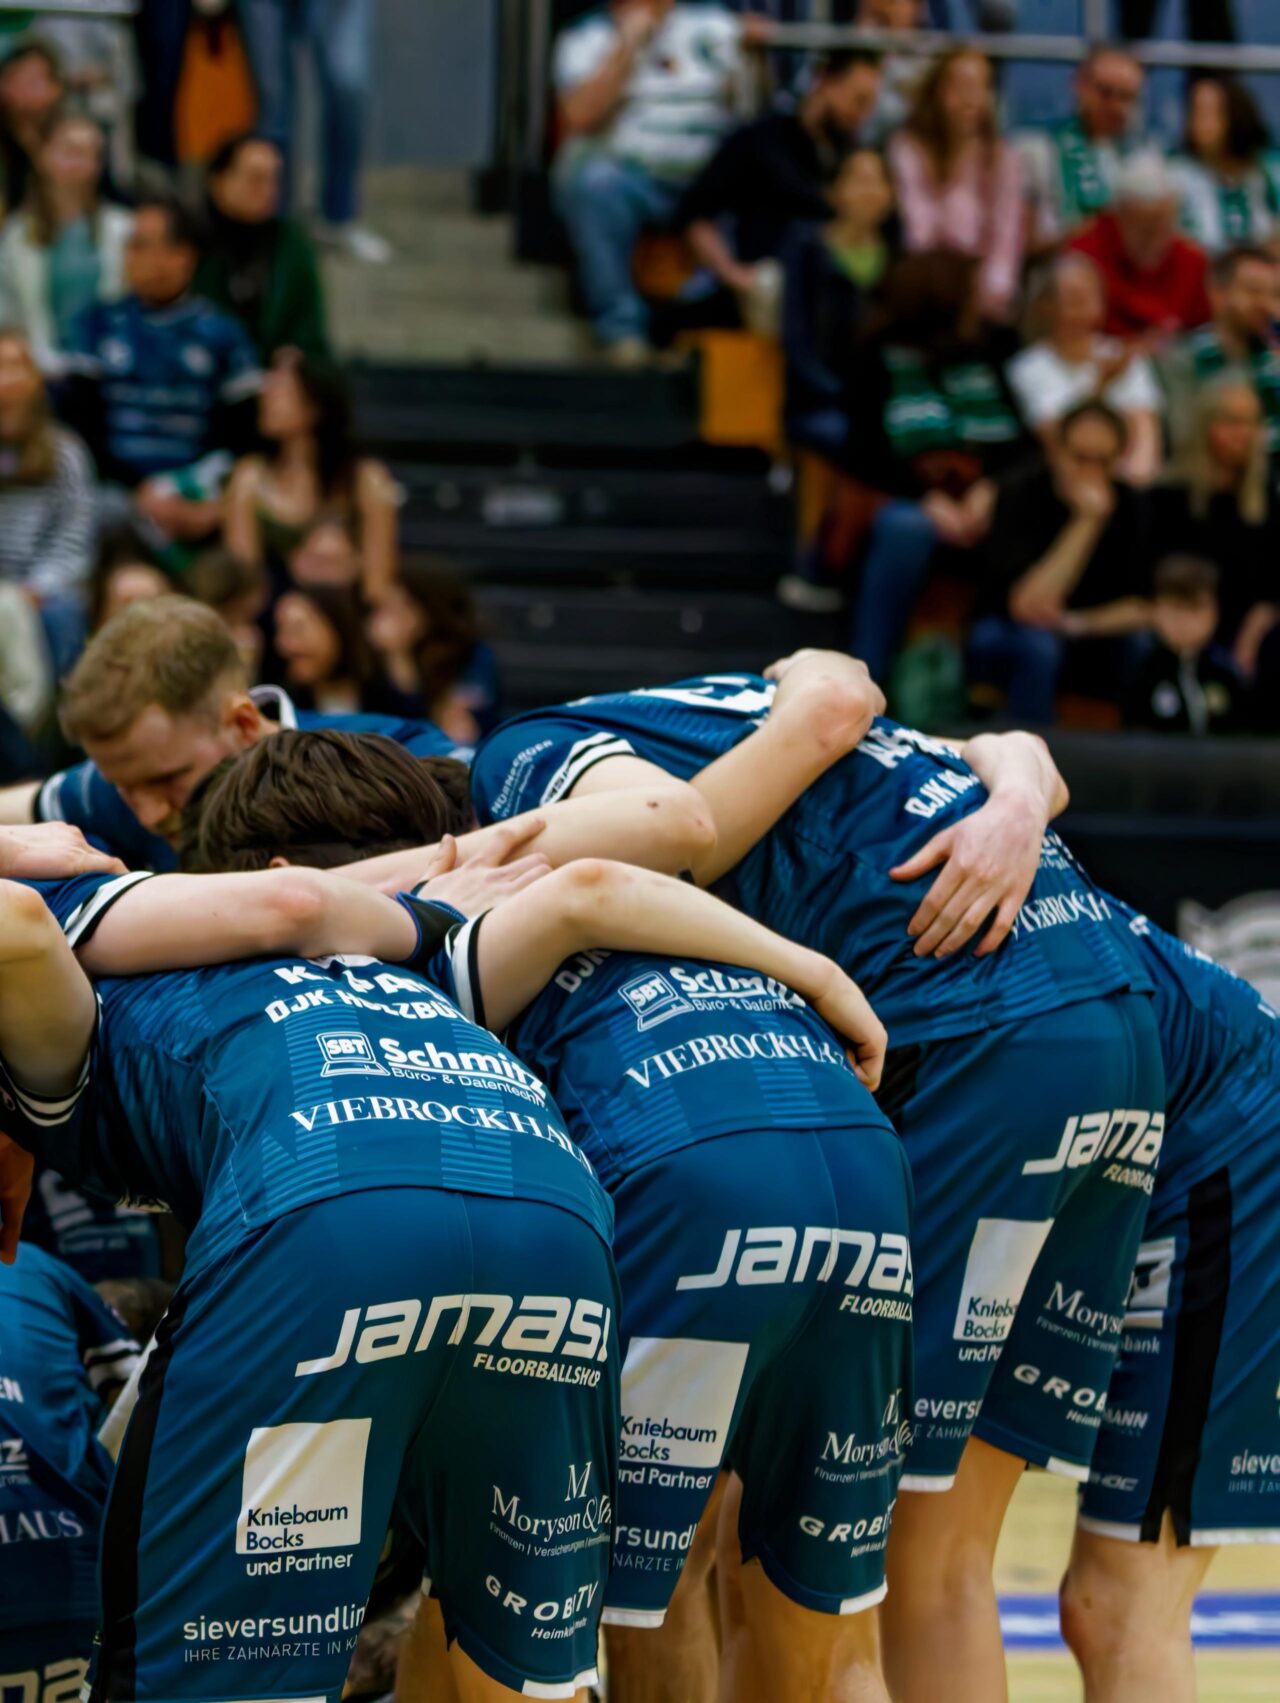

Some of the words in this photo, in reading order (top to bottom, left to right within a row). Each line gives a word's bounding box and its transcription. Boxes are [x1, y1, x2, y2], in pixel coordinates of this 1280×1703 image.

[629, 977, 667, 1007] SBT
[265, 989, 333, 1024] DJK
[326, 1038, 366, 1056] SBT
[379, 1037, 546, 1101] Schmitz
[391, 1066, 437, 1082] Büro-
[443, 1074, 454, 1085] &
[958, 1345, 987, 1363] und
[564, 1460, 593, 1502] M
[648, 1468, 713, 1490] Partner
[247, 1504, 348, 1527] Kniebaum
[491, 1484, 580, 1543] Moryson
[582, 1496, 599, 1533] &
[246, 1528, 304, 1551] Bocks
[246, 1556, 282, 1577] und
[285, 1553, 354, 1573] Partner
[485, 1573, 599, 1622] GROBITV
[183, 1600, 369, 1642] sieversundlin
[184, 1647, 220, 1663] IHRE
[227, 1643, 320, 1661] ZAHNÄRZTE
[327, 1641, 341, 1656] IN
